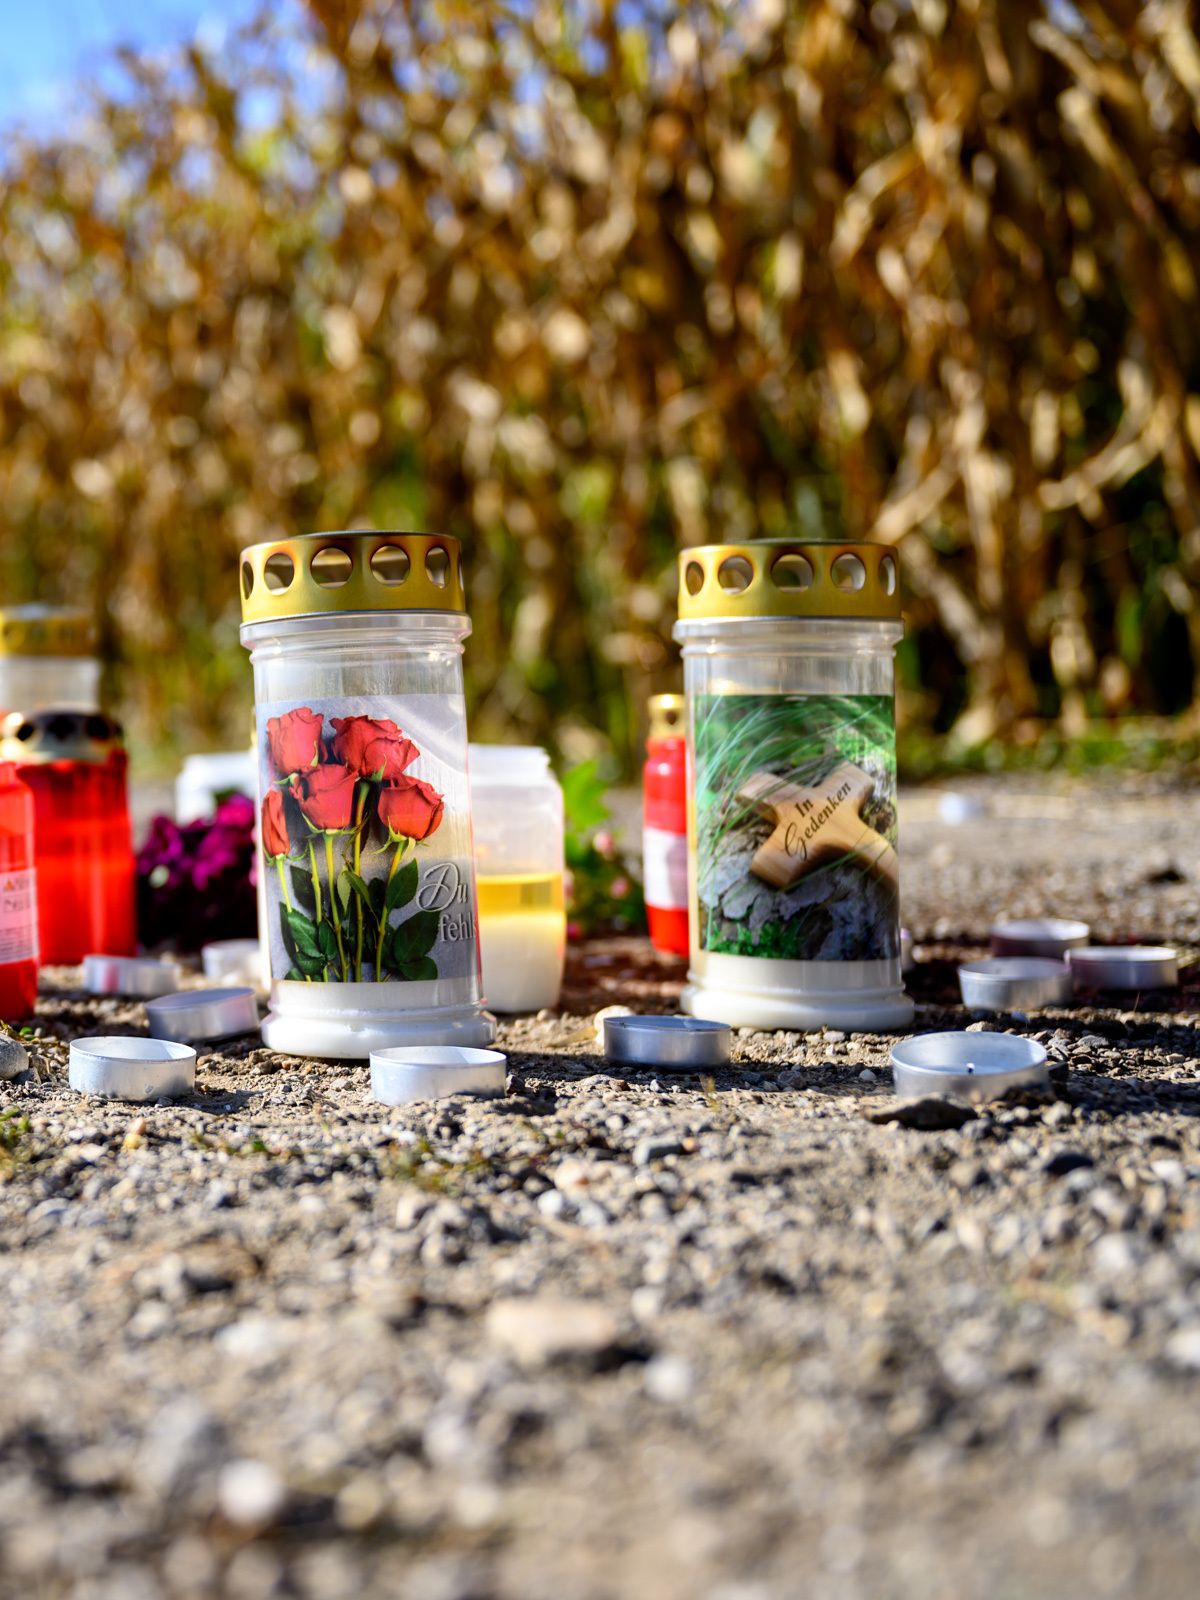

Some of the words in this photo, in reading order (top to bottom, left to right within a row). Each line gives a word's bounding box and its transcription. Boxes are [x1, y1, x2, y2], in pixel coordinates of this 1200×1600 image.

[784, 781, 851, 862] Gedenken
[794, 798, 814, 818] In
[415, 862, 468, 913] Du
